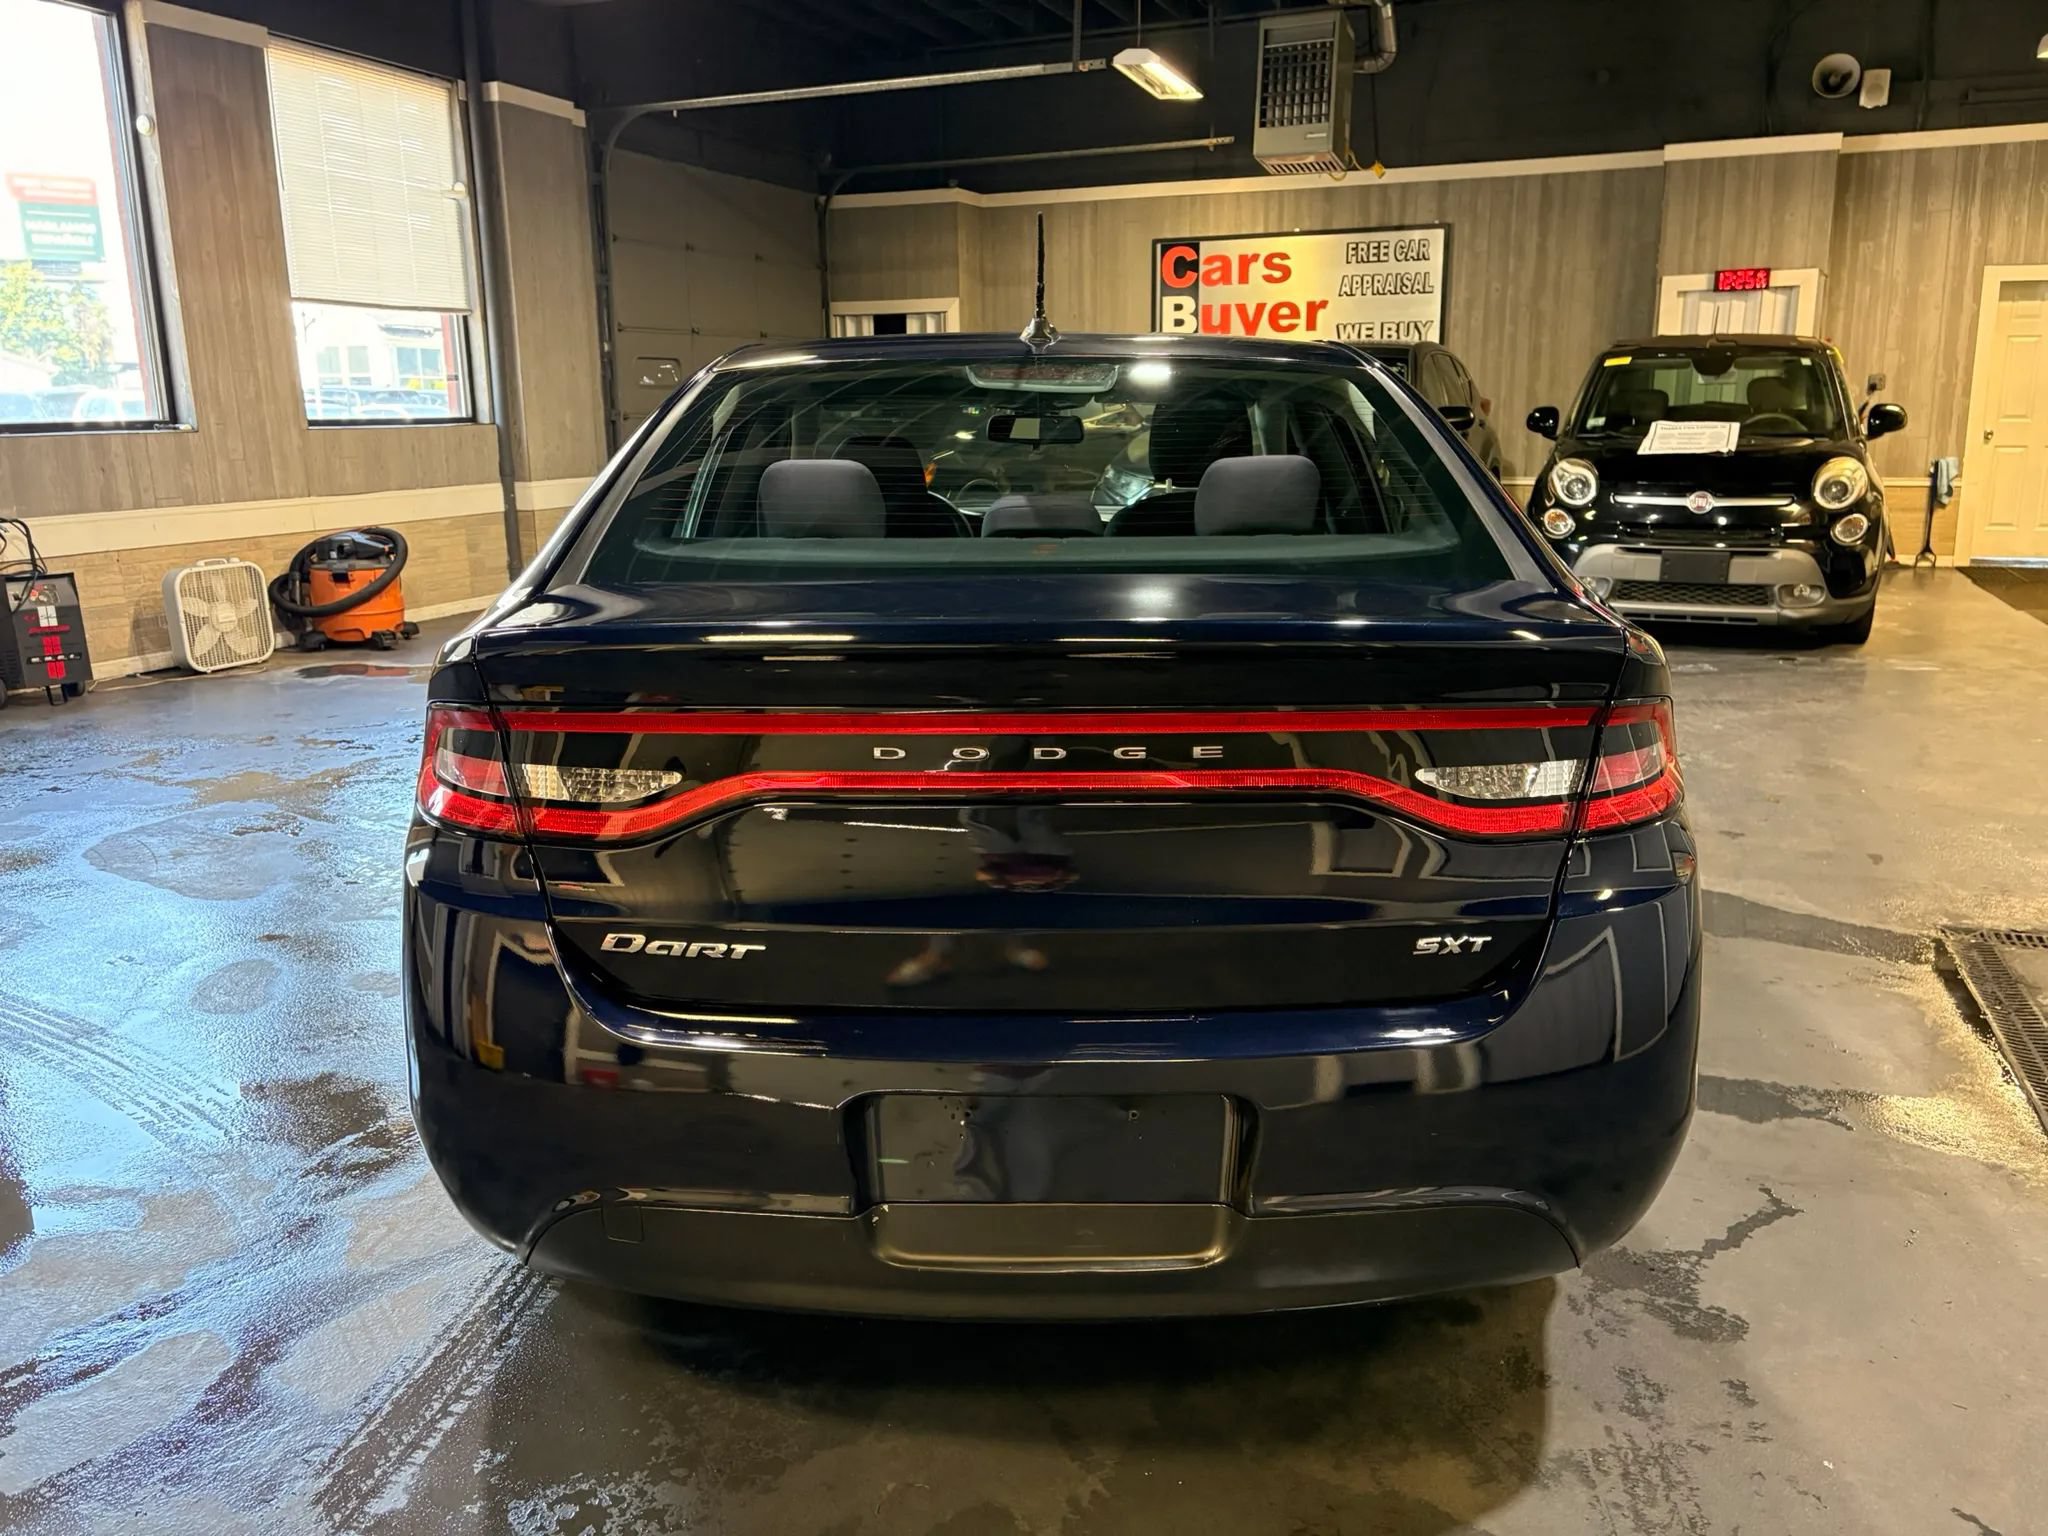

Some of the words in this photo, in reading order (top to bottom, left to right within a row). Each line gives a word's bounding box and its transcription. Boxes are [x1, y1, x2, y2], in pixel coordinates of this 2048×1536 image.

[1346, 240, 1390, 264] FREE
[1394, 239, 1431, 262] CAR
[1161, 245, 1292, 289] Cars
[1338, 272, 1434, 297] APPRAISAL
[1336, 322, 1376, 340] WE
[1380, 320, 1434, 341] BUY
[873, 745, 1224, 760] DODGE
[1412, 935, 1493, 955] SXT
